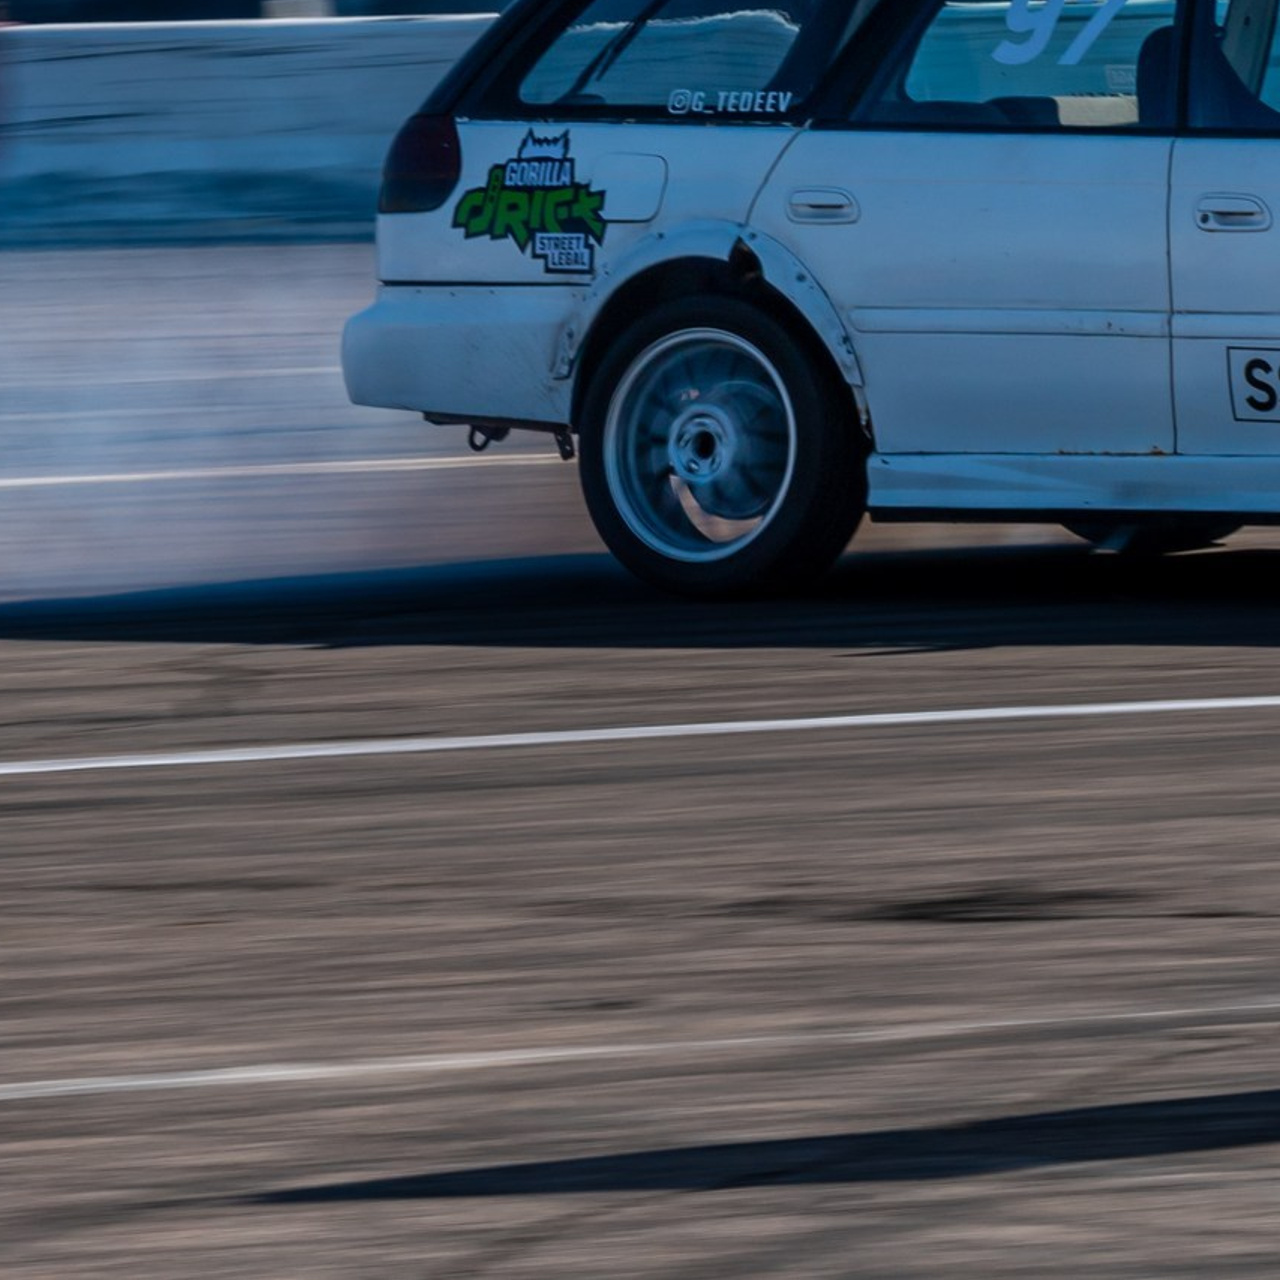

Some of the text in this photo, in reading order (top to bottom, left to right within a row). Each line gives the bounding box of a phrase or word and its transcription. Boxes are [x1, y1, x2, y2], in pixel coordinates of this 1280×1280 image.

[505, 161, 571, 187] GORILLA
[538, 235, 583, 252] STREET
[551, 251, 587, 267] LEGAL
